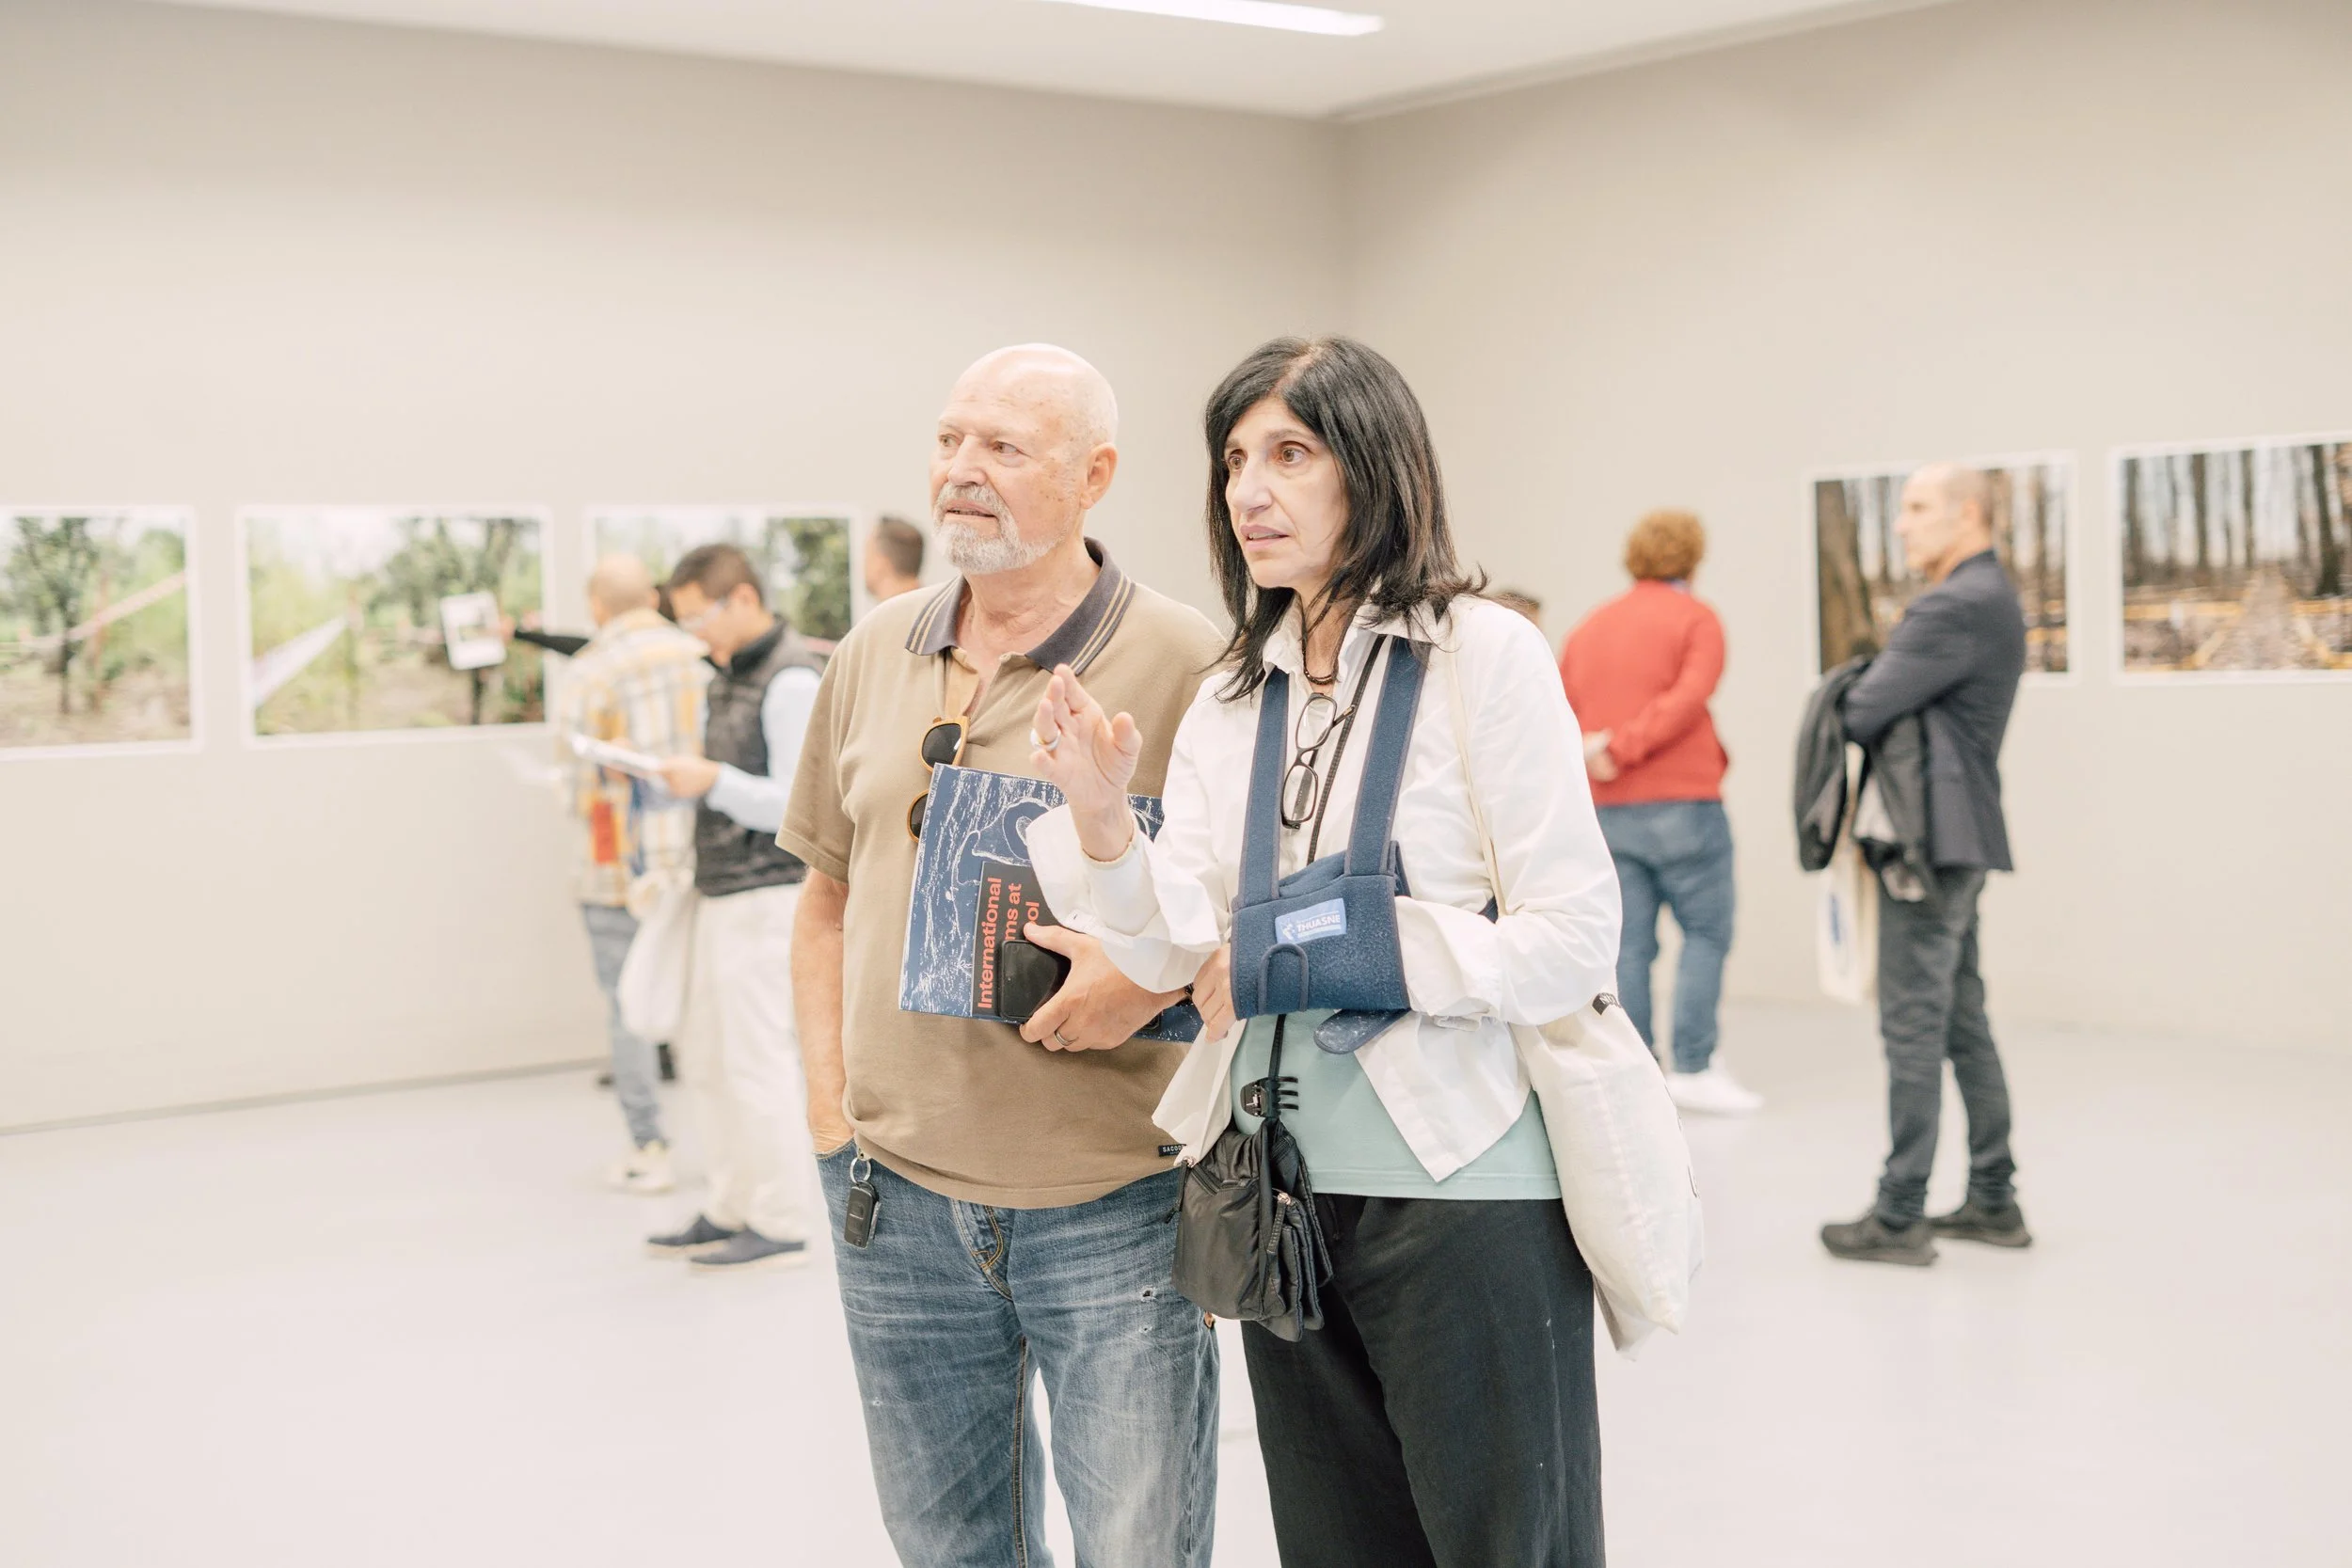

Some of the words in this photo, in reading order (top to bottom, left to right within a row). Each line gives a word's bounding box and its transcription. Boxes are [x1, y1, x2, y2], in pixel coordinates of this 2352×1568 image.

[1008, 882, 1022, 905] at
[1025, 901, 1040, 923] ol
[1297, 914, 1341, 932] THUASNE
[1005, 908, 1019, 941] ms
[977, 877, 1002, 1009] International
